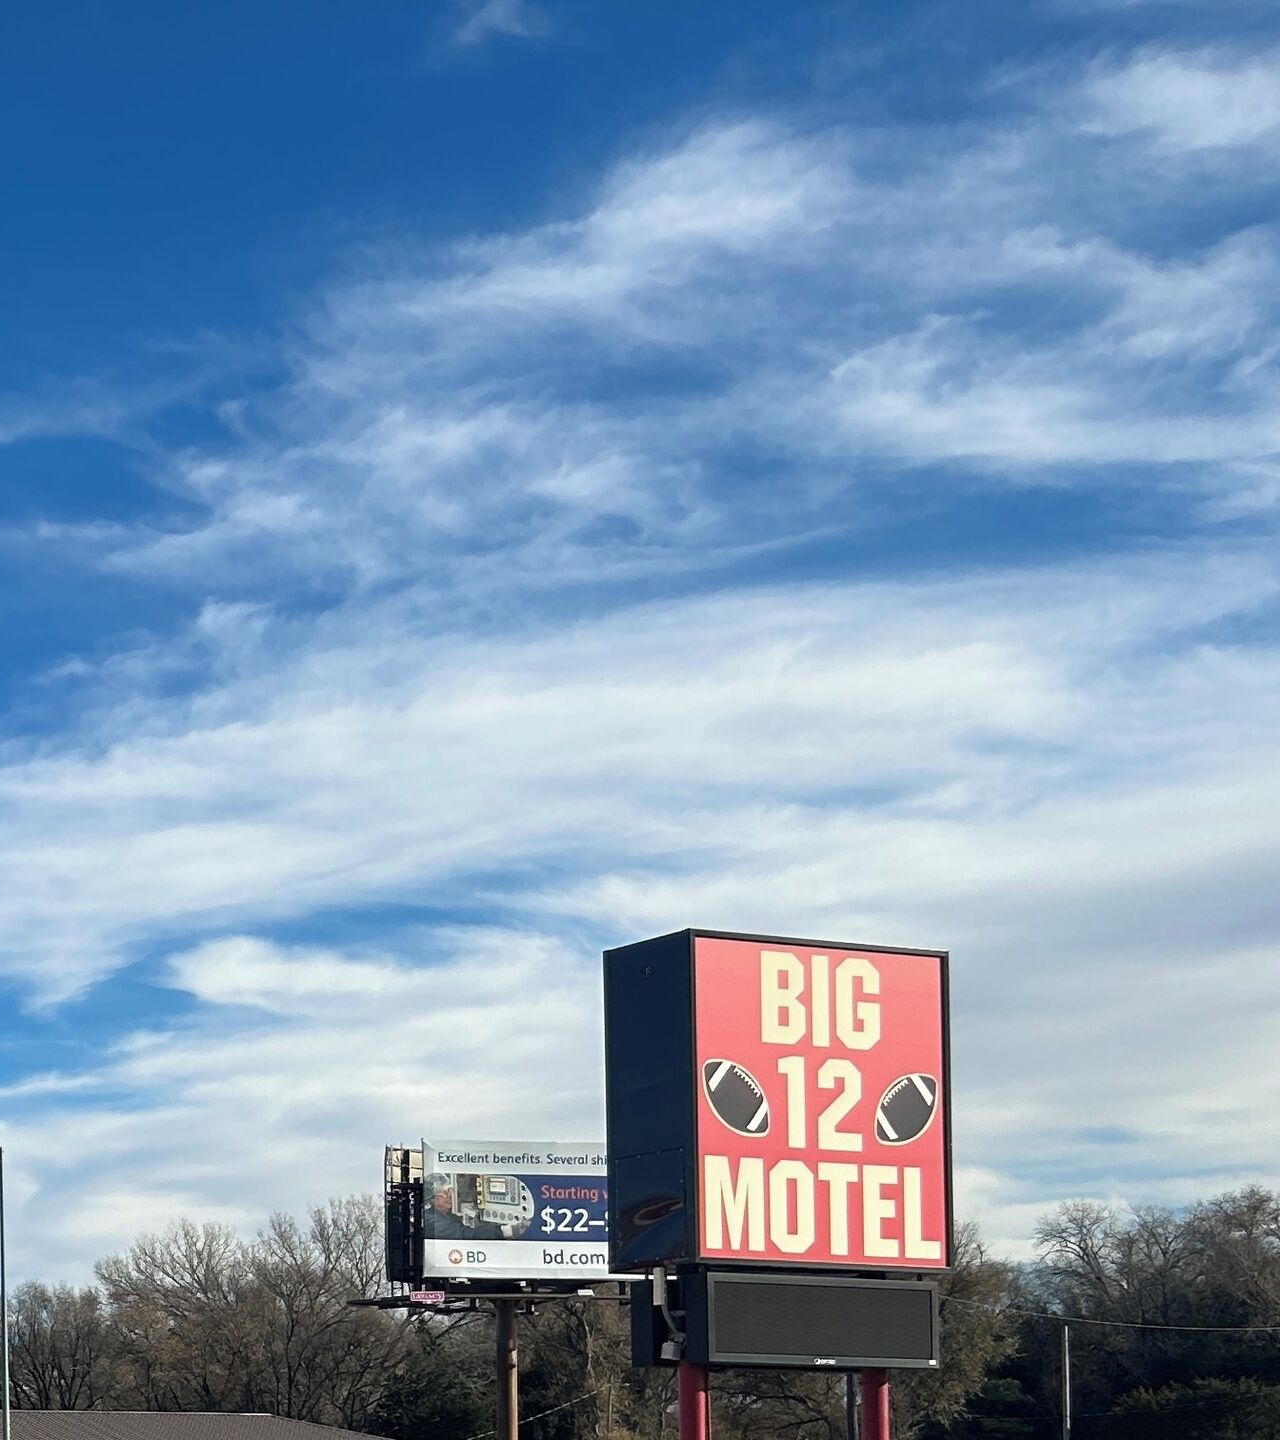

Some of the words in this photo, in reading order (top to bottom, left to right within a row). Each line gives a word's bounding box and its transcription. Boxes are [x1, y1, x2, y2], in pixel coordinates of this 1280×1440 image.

[760, 949, 882, 1051] BIG
[777, 1055, 863, 1152] 12
[437, 1151, 490, 1164] Excellent
[492, 1152, 543, 1165] benefits.
[546, 1153, 589, 1165] Several
[591, 1154, 608, 1166] shi
[541, 1184, 599, 1203] Starting
[704, 1154, 941, 1260] MOTEL
[540, 1205, 608, 1235] $22–
[466, 1251, 487, 1264] BD
[543, 1248, 608, 1265] bd.com
